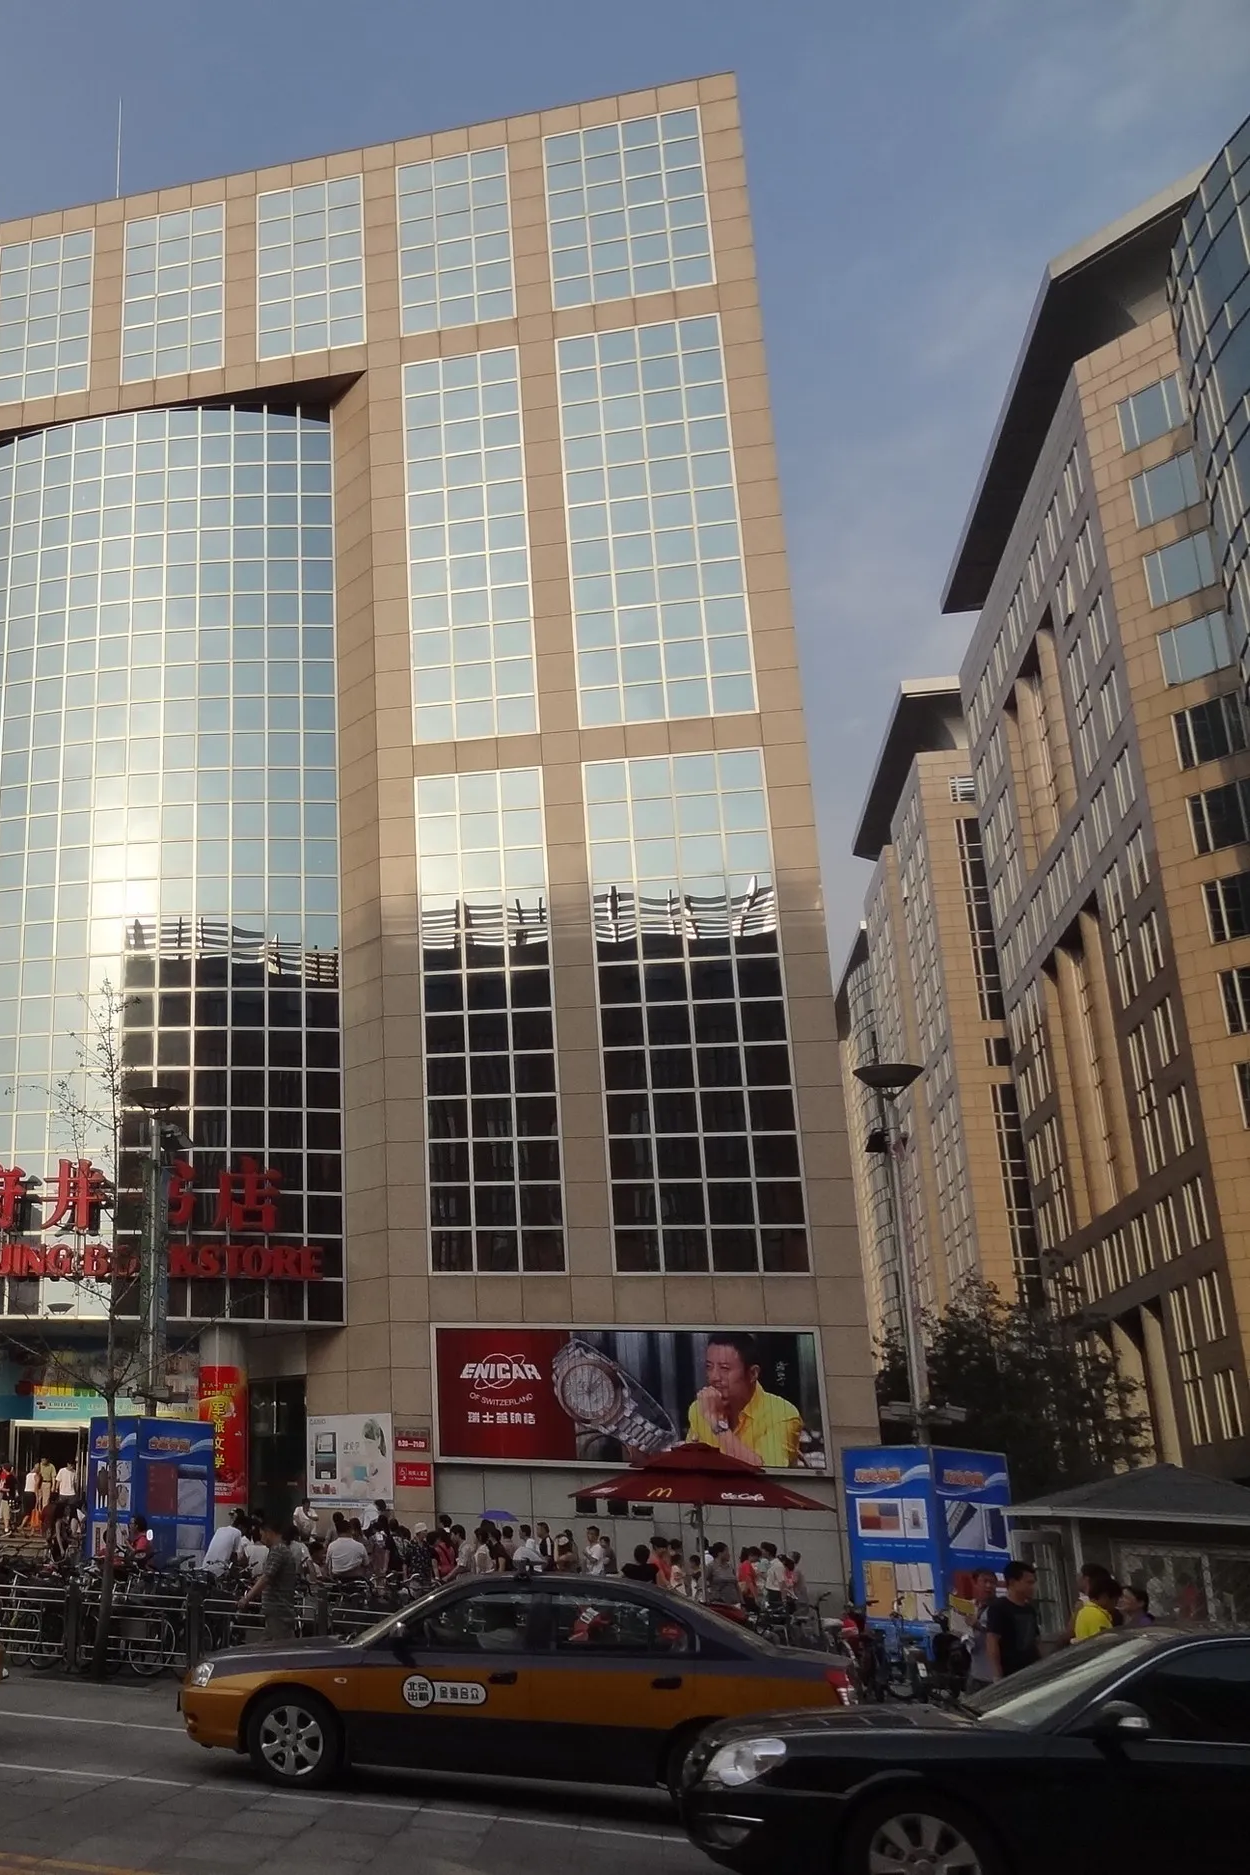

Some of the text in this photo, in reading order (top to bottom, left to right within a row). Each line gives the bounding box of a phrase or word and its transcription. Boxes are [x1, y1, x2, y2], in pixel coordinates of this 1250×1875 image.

[82, 1244, 325, 1281] BOKSTORE
[459, 1363, 542, 1380] ENICAR
[469, 1391, 534, 1407] OF SWITZERLAND
[212, 1401, 226, 1469] 军旅文学
[407, 1681, 429, 1692] 北京
[407, 1692, 430, 1702] 出租
